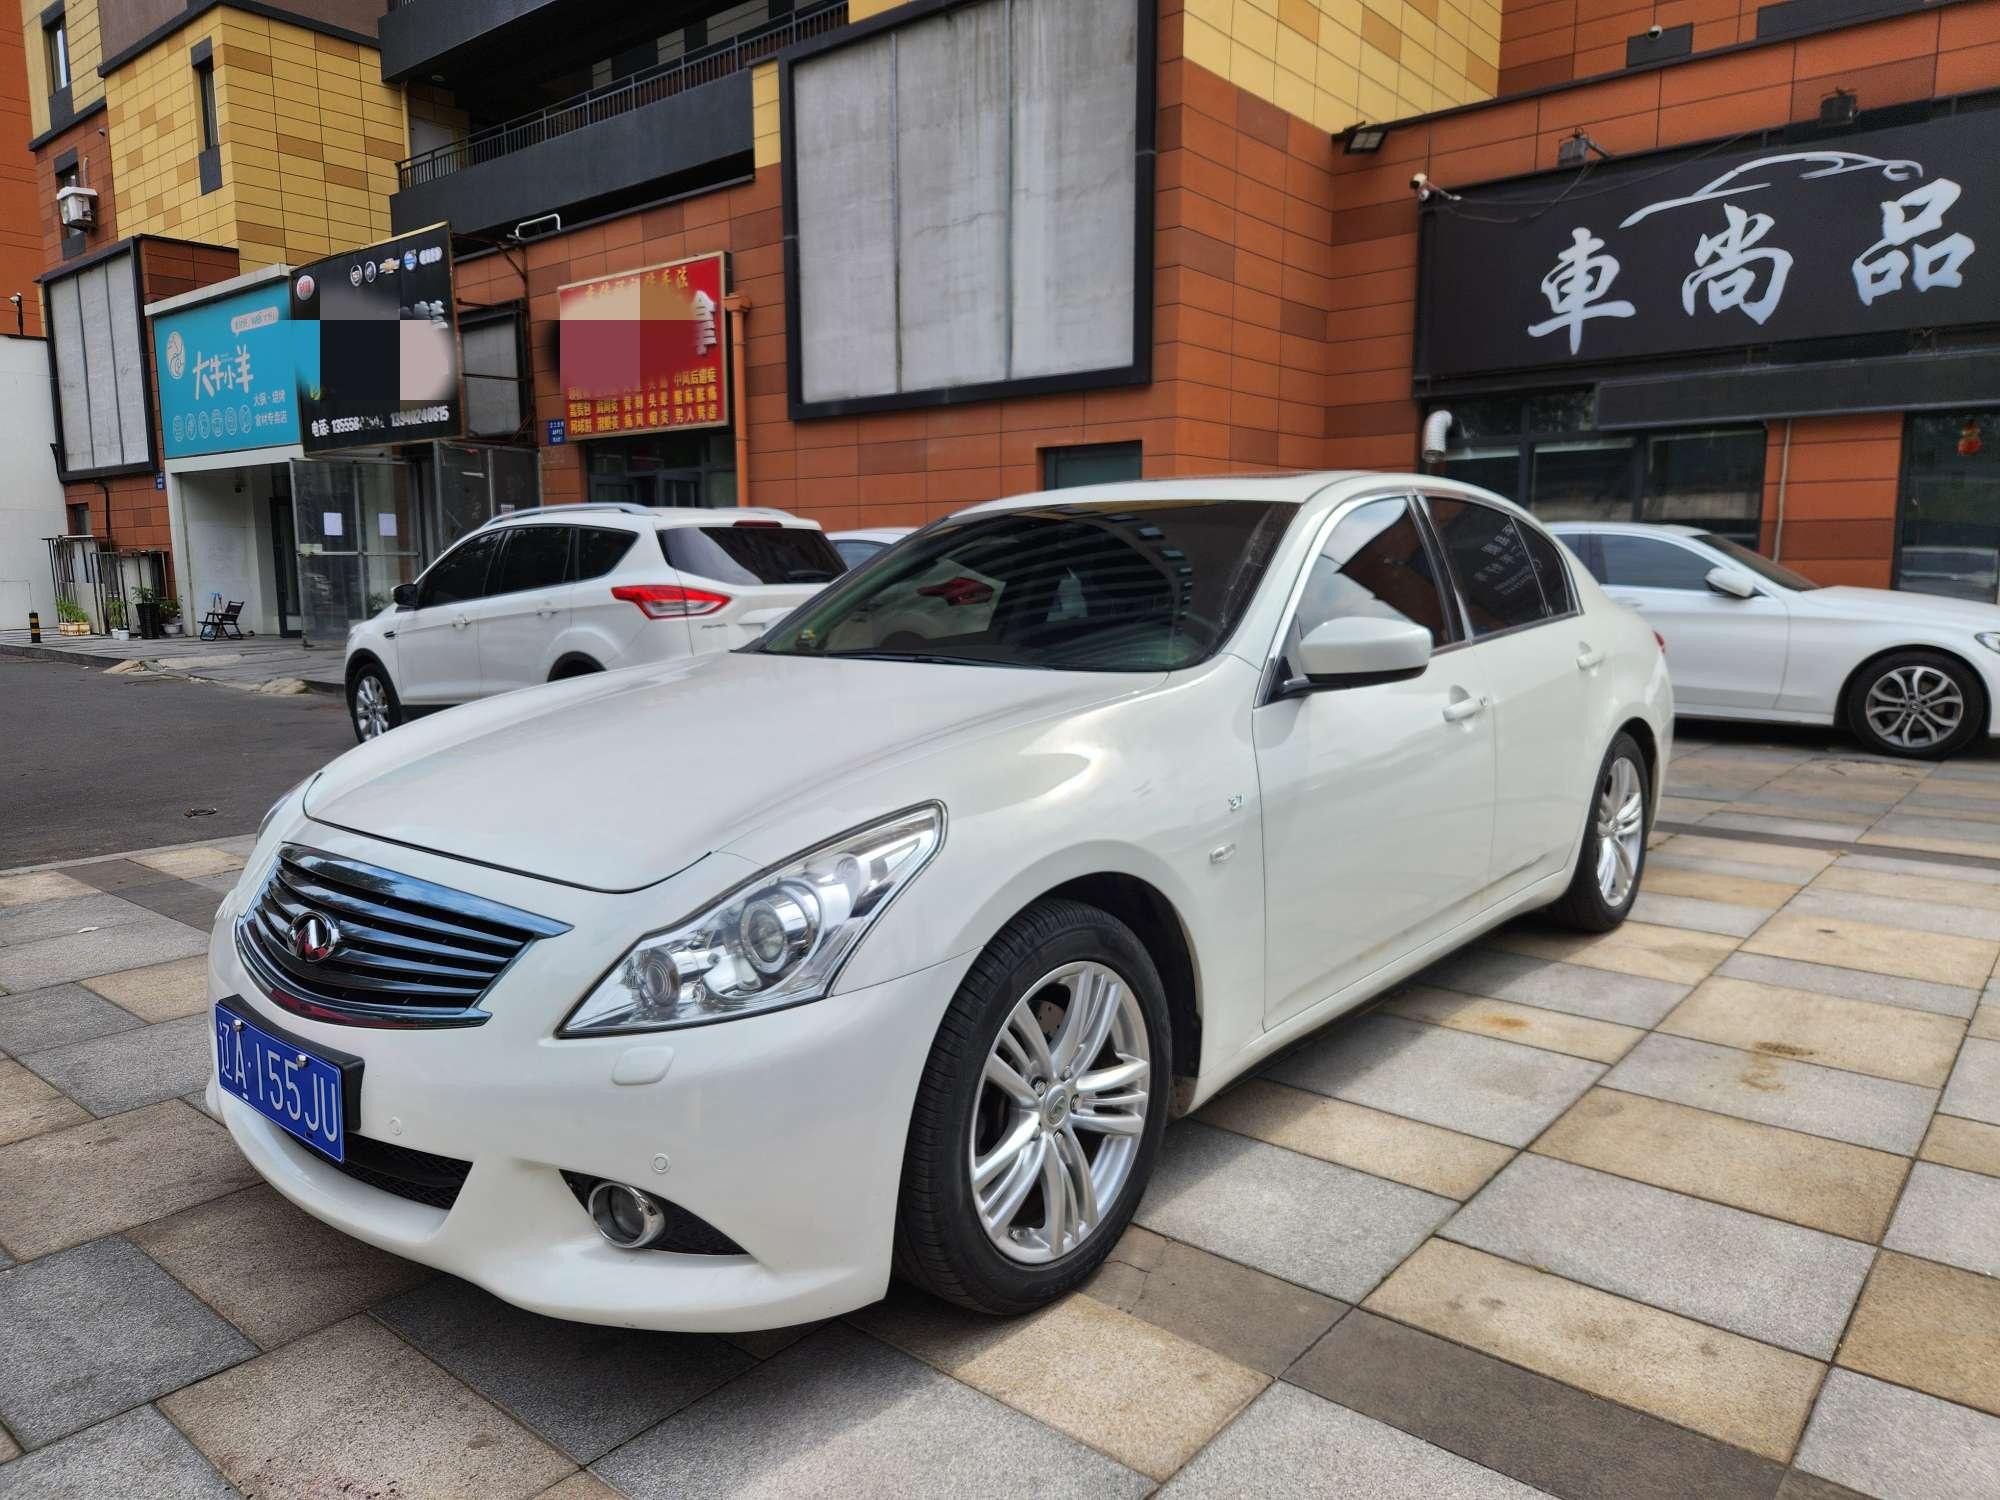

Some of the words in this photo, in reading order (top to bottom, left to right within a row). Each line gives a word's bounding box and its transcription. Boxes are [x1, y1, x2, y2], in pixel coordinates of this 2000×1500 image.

[1527, 177, 1976, 356] 車尚品
[192, 343, 254, 401] 大牛小羊
